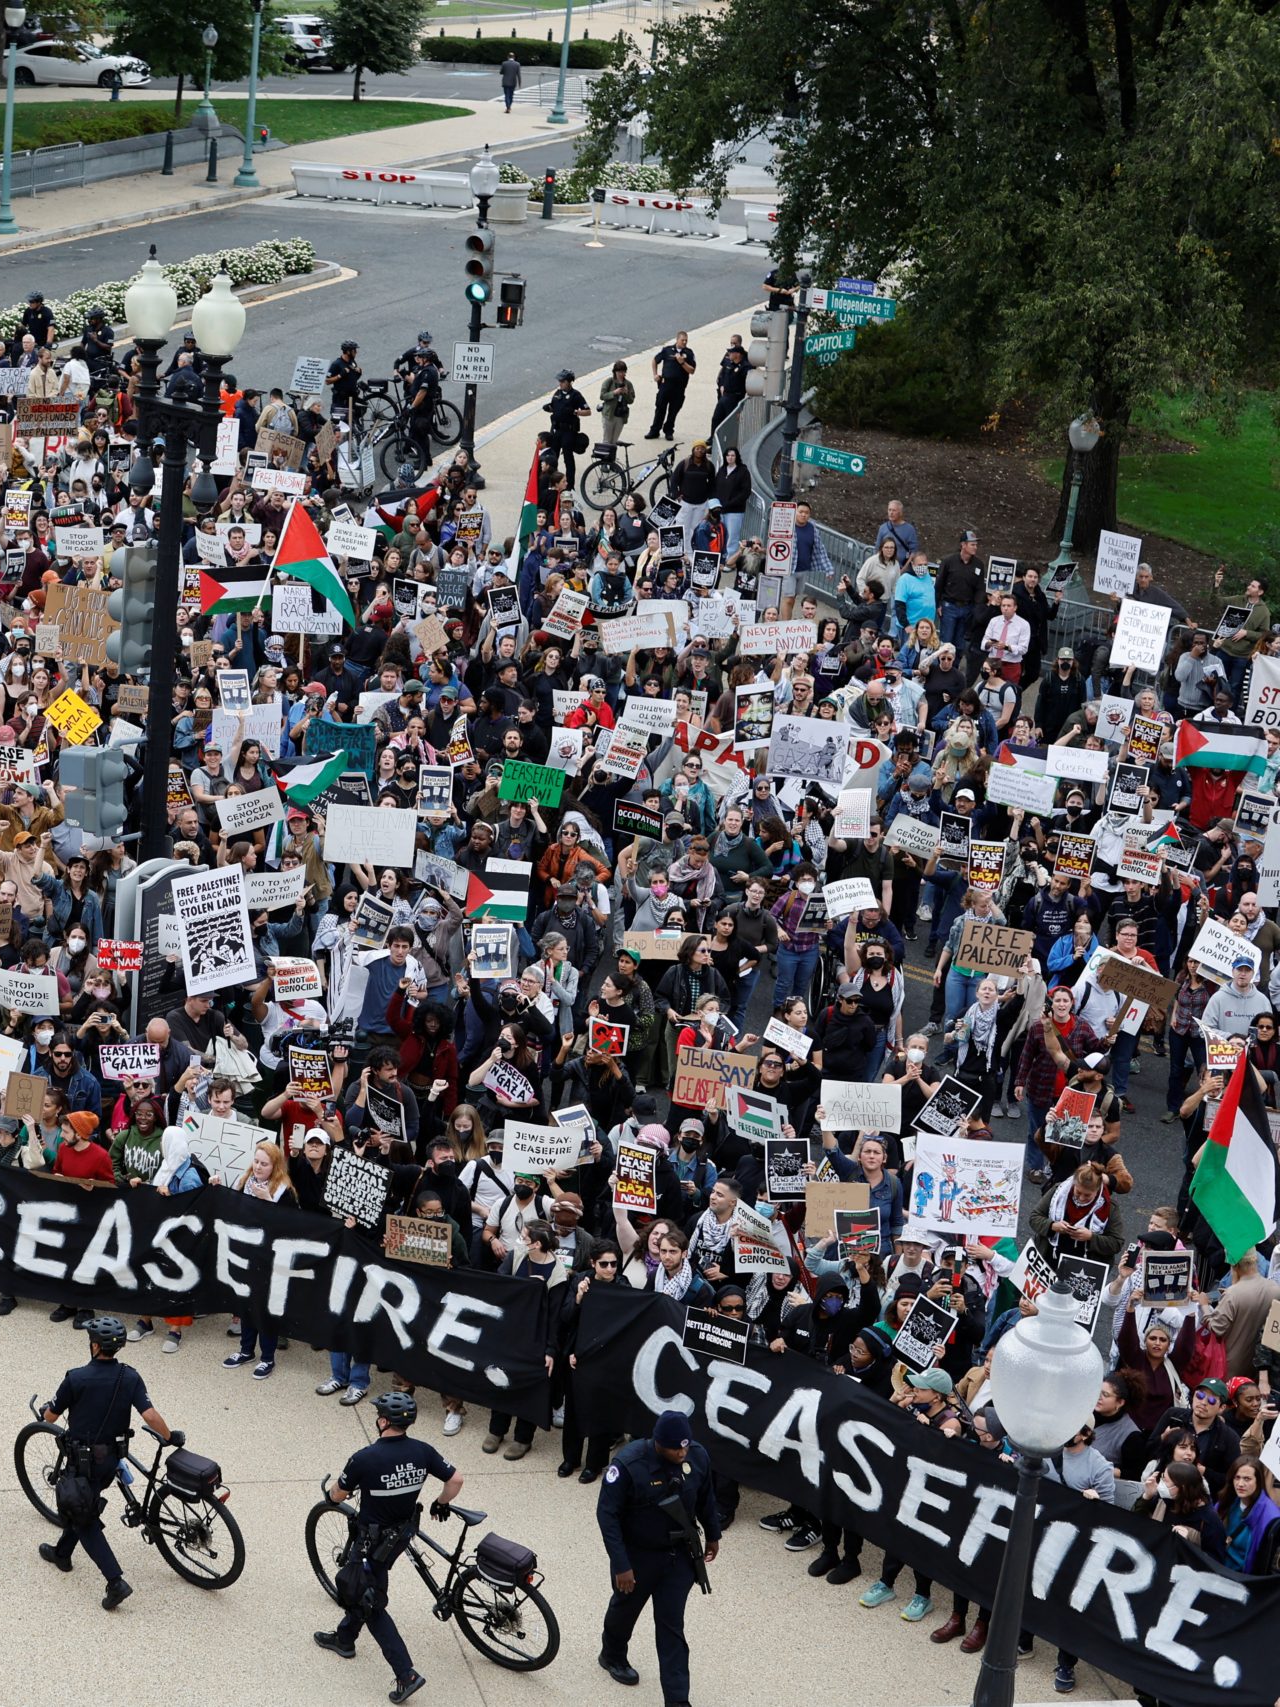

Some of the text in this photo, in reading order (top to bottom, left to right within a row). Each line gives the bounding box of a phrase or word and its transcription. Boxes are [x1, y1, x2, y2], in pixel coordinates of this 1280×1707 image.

[342, 170, 416, 184] STOP
[611, 195, 694, 211] STOP
[831, 294, 882, 315] Independence
[839, 313, 864, 325] UNIT
[806, 335, 844, 353] CAPITOL
[462, 355, 486, 363] TURN
[818, 352, 838, 363] 100
[0, 368, 26, 377] STOP
[455, 372, 488, 381] 7AM-7PM
[32, 404, 78, 414] GENOCIDE
[17, 428, 78, 437] FREE PALESTINE
[261, 430, 304, 451] CEASEFIRE
[255, 471, 305, 489] FREE PALESTINE
[7, 497, 31, 506] CEASE
[9, 504, 26, 513] FIRE
[6, 512, 29, 521] GAZA
[61, 539, 99, 547] GENOCIDE
[334, 536, 370, 548] CEASEFIRE
[340, 544, 358, 552] NOW
[439, 582, 464, 595] SIEGE
[438, 594, 464, 608] NOW
[275, 620, 341, 635] COLONIZATION
[745, 624, 813, 639] NEVER AGAIN
[1127, 650, 1157, 666] GAZA
[50, 696, 73, 722] LET
[59, 709, 88, 734] GAZA
[69, 720, 97, 745] LIVE
[773, 750, 821, 768] GAZA
[505, 763, 565, 783] CEASEFIRE
[514, 782, 554, 801] NOW!
[236, 798, 260, 812] STOP
[229, 803, 276, 823] GENOCIDE
[333, 809, 415, 830] PALESTINIAN
[911, 826, 934, 839] STOP
[972, 850, 1004, 863] CEASE
[974, 860, 1000, 871] FIRE
[970, 870, 1002, 884] GAZA
[176, 874, 241, 898] FREE PALESTINE!
[179, 886, 241, 907] GIVE BACK THE
[249, 891, 300, 905] APARTHEID
[180, 894, 242, 920] STOLEN LAND
[969, 924, 1027, 948] FREE
[99, 956, 143, 969] MY NAME
[960, 944, 1028, 970] PALESTINE
[8, 979, 36, 990] STOP
[277, 981, 319, 994] GENOCIDE
[289, 976, 305, 985] NOT
[4, 994, 44, 1009] IN GAZA
[100, 1044, 158, 1058] CEASEFIRE
[681, 1047, 755, 1087] JEWS SAY
[840, 1086, 871, 1100] JEWS
[833, 1100, 889, 1115] AGAINST
[826, 1113, 896, 1128] APARTHEID
[516, 1131, 573, 1145] JEWS SAY:
[513, 1143, 573, 1156] CEASEFIRE
[529, 1156, 557, 1167] NOW
[619, 1155, 653, 1173] CEASE
[331, 1157, 387, 1191] NEUTRAL
[623, 1166, 649, 1183] FIRE
[616, 1180, 654, 1197] GAZA
[620, 1193, 650, 1207] NOW!
[737, 1207, 772, 1233] CONGRESS
[752, 1247, 769, 1257] NOT
[738, 1253, 786, 1268] GENOCIDE
[686, 1319, 747, 1344] SETTLER COLONIALISM
[386, 1477, 424, 1489] POLICE
[632, 1325, 1242, 1690] CEASEFIRE.
